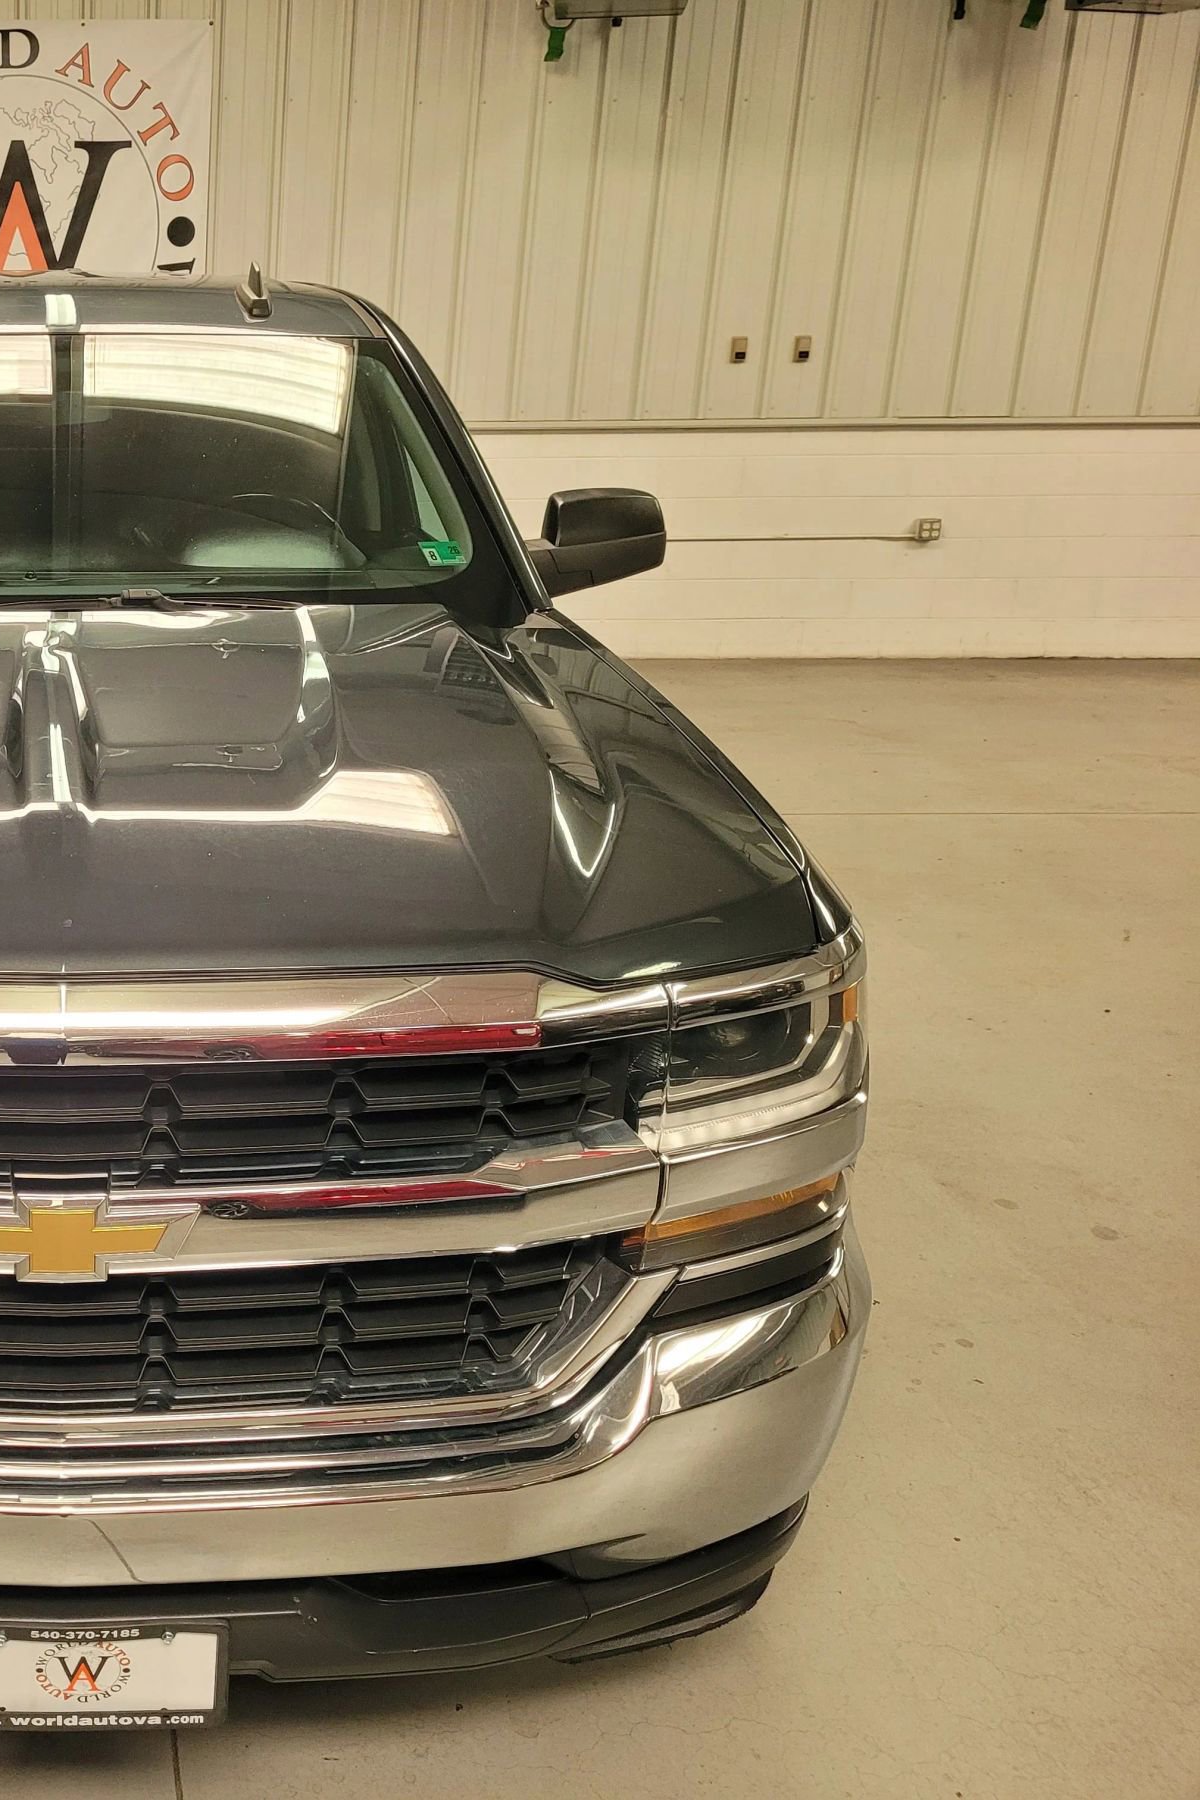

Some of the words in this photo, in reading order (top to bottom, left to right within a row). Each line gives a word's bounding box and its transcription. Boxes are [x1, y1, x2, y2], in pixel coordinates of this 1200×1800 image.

[55, 42, 195, 202] AUTO
[429, 551, 437, 560] 8
[448, 545, 460, 554] 26
[30, 1628, 140, 1639] 540-370-7185
[93, 1640, 131, 1666] AUTO
[36, 1674, 73, 1701] AUTO
[77, 1674, 131, 1703] WORLD
[10, 1715, 162, 1727] worldautova
